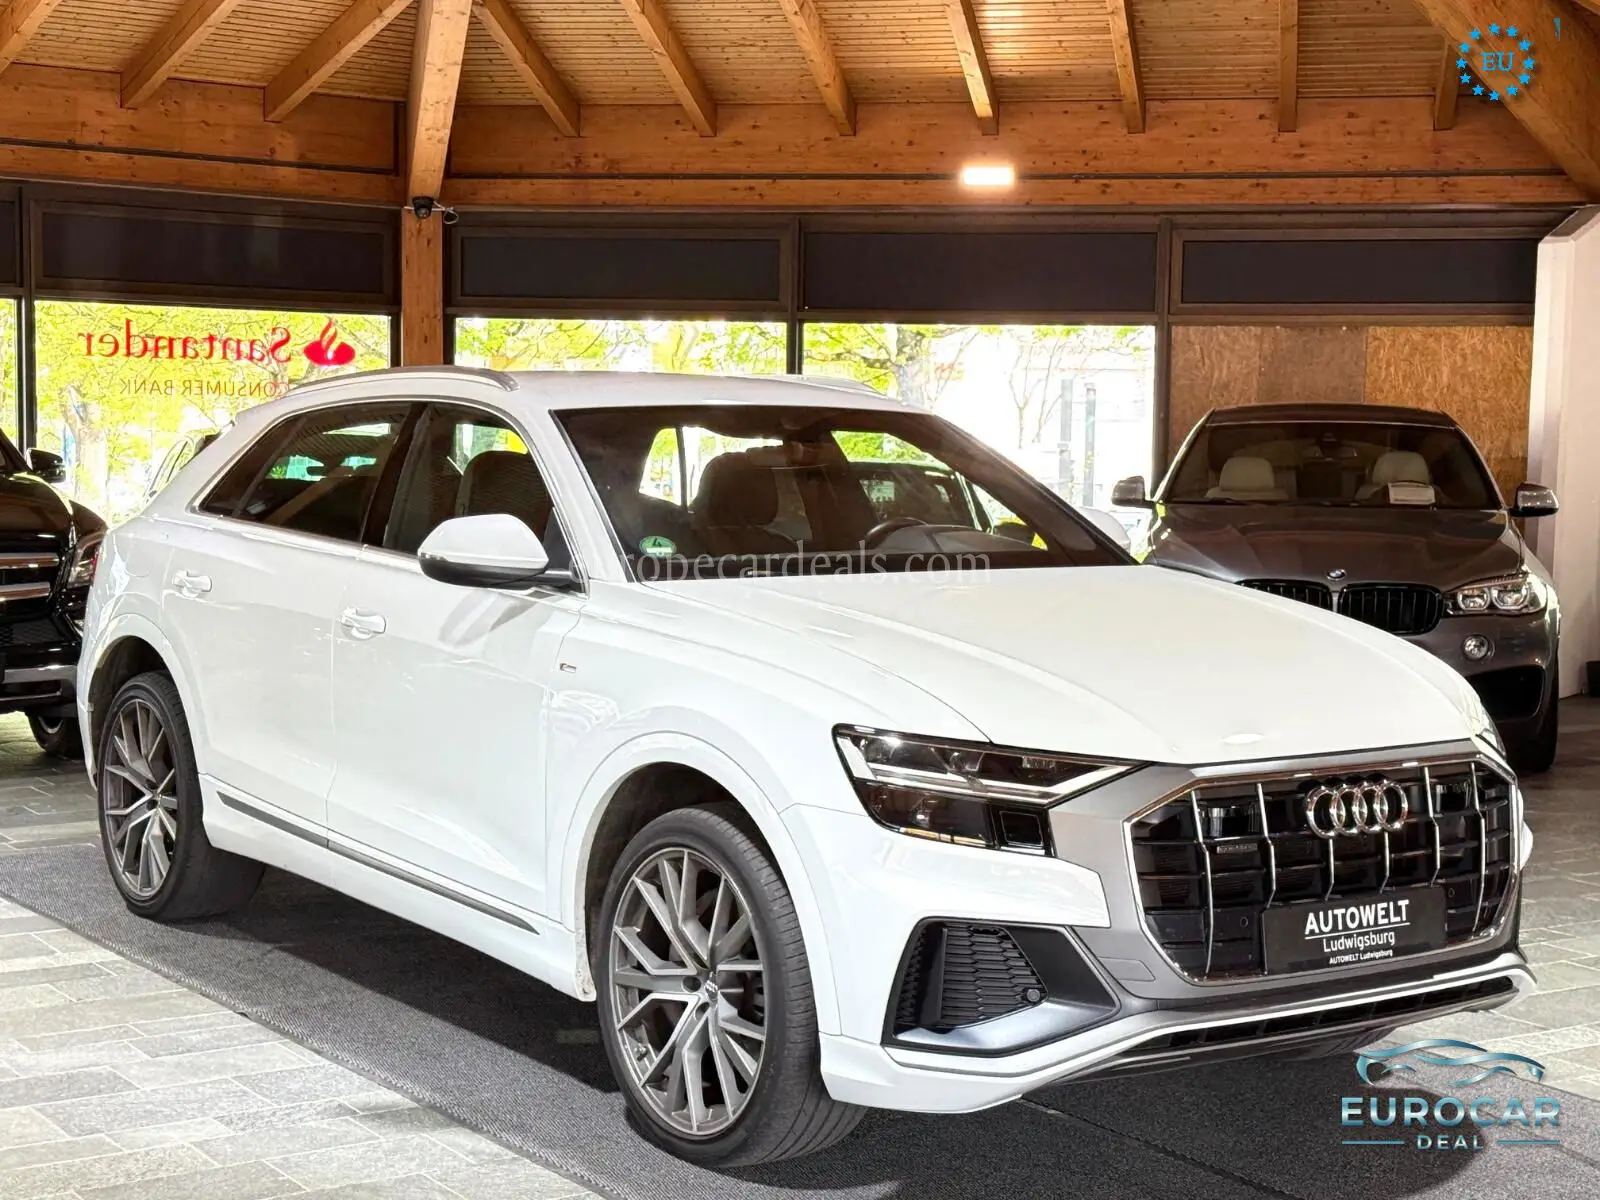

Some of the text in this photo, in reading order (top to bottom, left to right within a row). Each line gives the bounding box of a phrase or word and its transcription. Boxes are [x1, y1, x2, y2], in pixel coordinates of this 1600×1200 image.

[1304, 899, 1409, 935] AUTOWELT
[1323, 932, 1395, 952] Ludwigsburg
[1329, 949, 1393, 965] AUTOWELT Ludwigsburg
